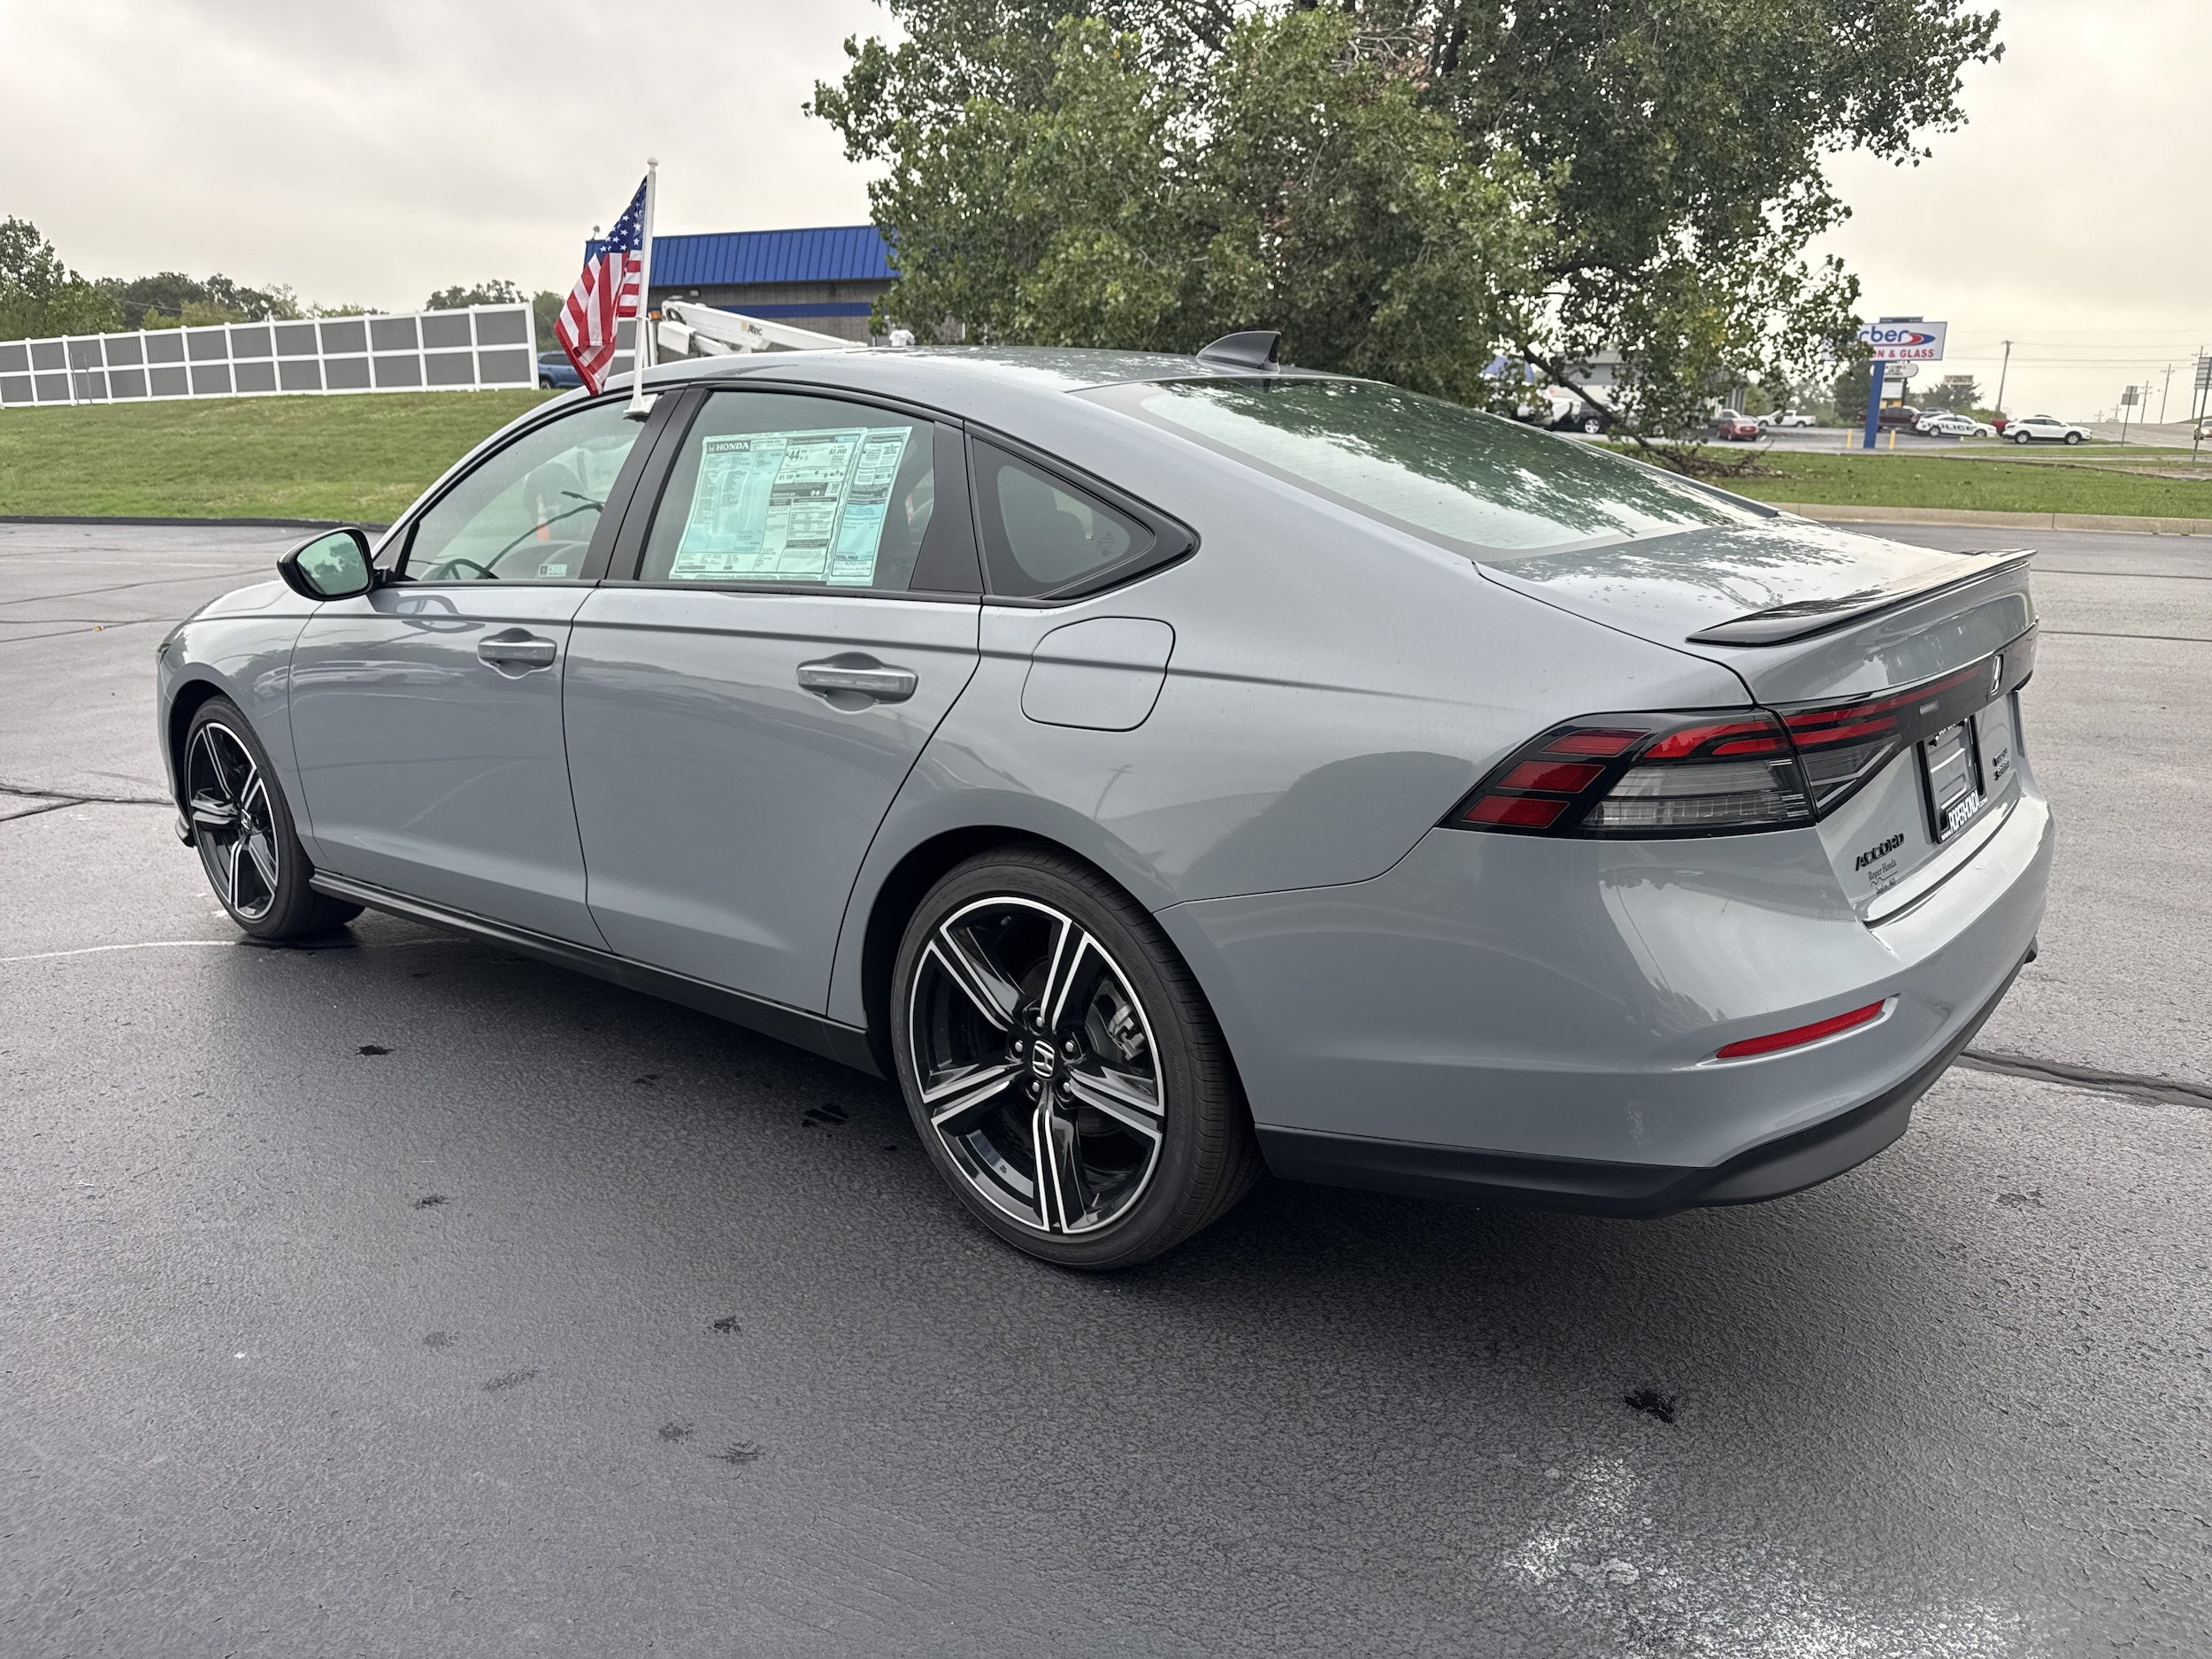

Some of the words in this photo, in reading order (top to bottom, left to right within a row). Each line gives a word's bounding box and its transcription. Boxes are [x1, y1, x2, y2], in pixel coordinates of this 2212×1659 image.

[1858, 326, 1909, 342] rber
[1900, 349, 1934, 358] GLASS
[716, 442, 749, 451] HONDA
[1855, 833, 1905, 872] ACCORD
